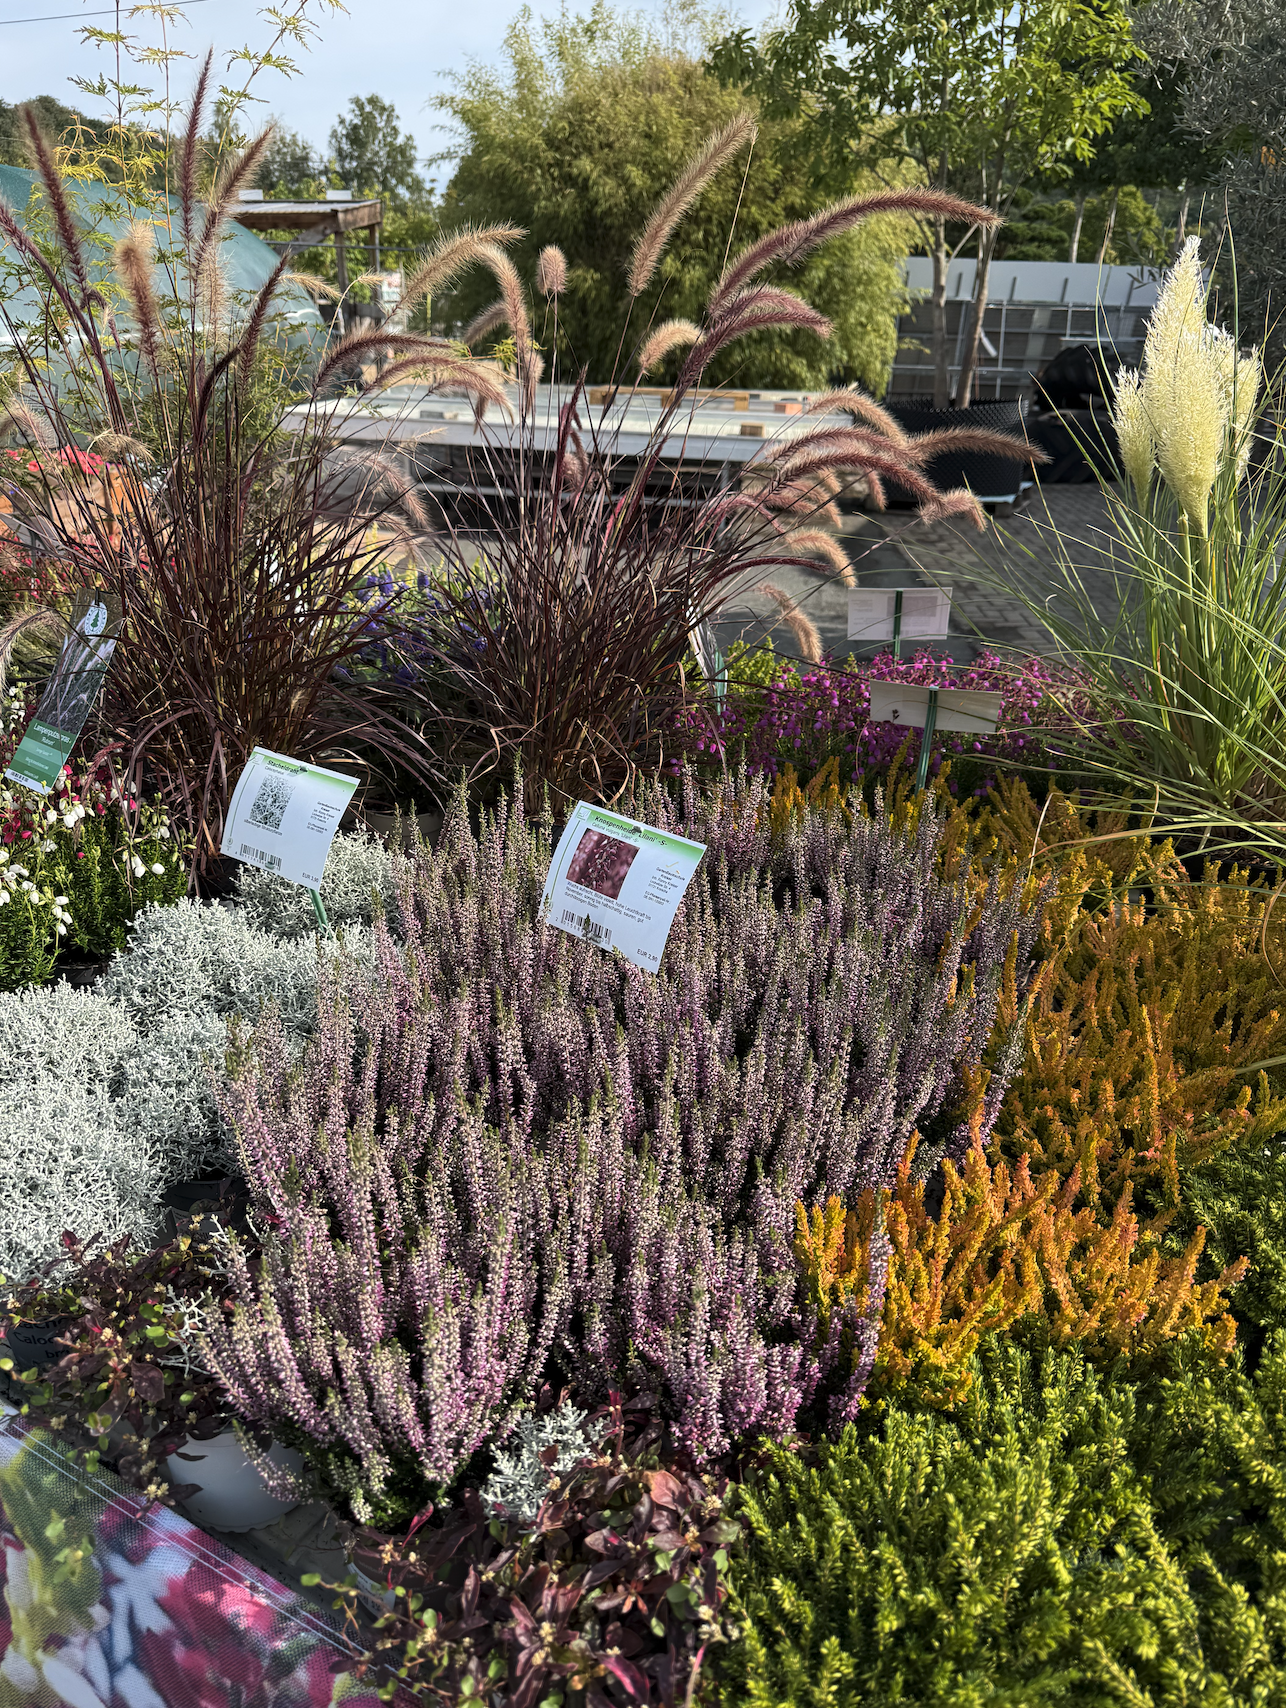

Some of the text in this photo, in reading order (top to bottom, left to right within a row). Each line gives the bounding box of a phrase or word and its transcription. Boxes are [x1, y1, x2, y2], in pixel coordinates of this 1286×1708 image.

[595, 816, 636, 835] Knospenheide
[636, 948, 658, 962] EUR 2,90
